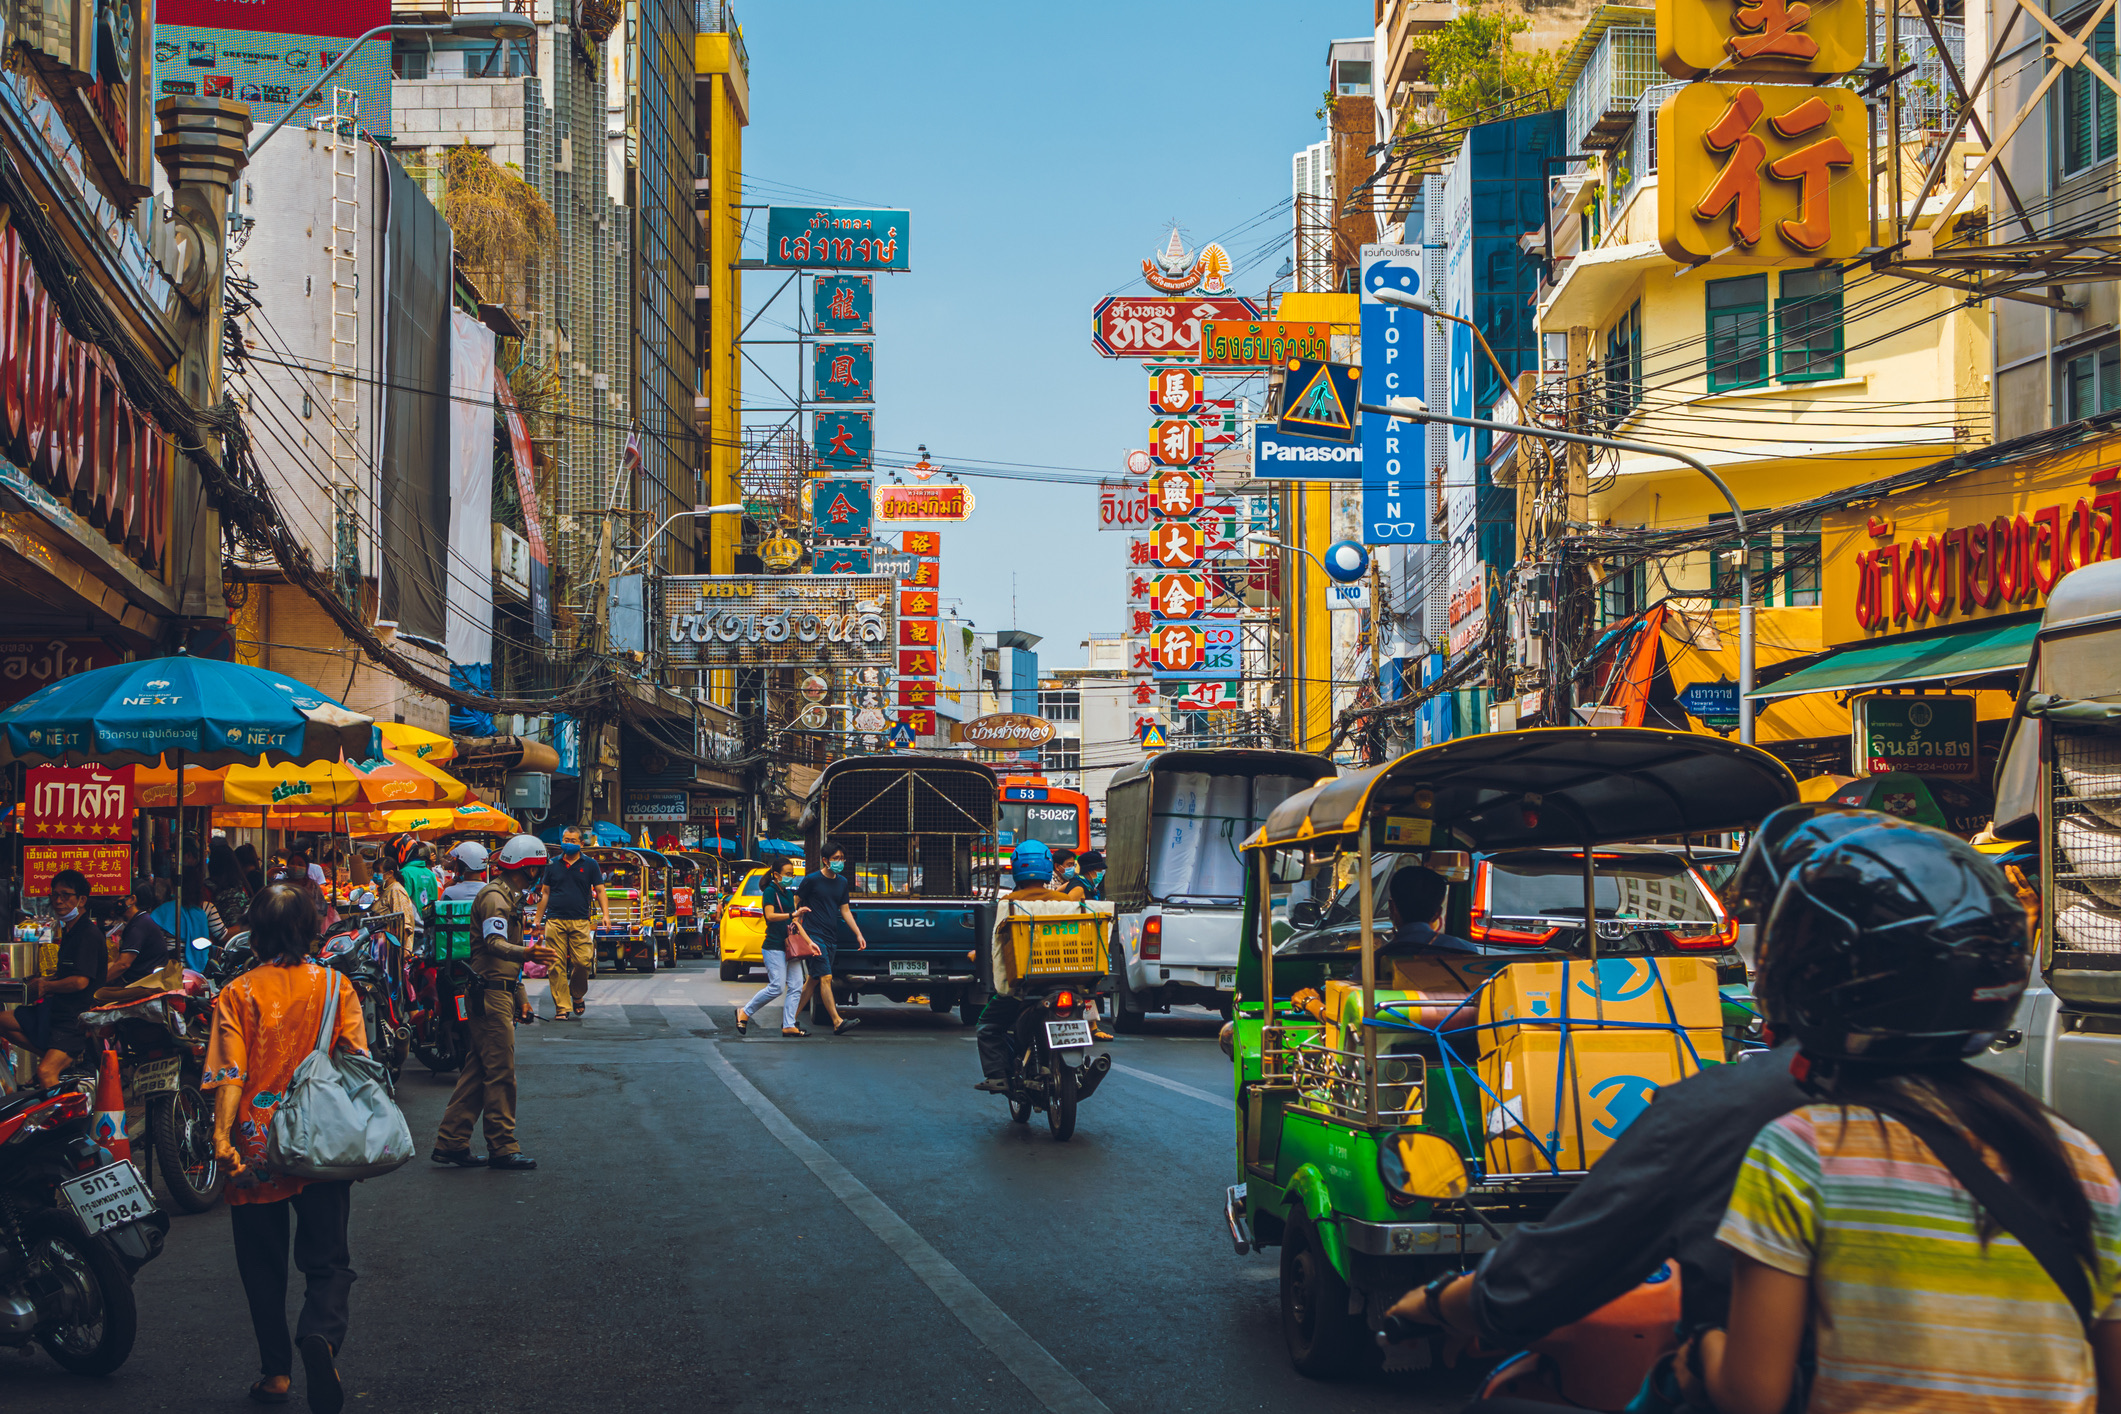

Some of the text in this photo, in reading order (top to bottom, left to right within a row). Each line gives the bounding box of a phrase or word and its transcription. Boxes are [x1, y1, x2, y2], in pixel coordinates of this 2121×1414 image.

[223, 51, 279, 60] GREYHOUND
[262, 85, 291, 94] TACO
[263, 93, 291, 103] BELL
[808, 212, 872, 230] ห้างทอง
[1111, 302, 1175, 318] ห้างทอง
[1203, 323, 1327, 361] โรงรับจำนำ
[1385, 307, 1400, 365] TOP
[1261, 441, 1363, 462] Panasoni
[702, 584, 753, 597] ทอง
[122, 696, 183, 706] NEXT
[1690, 690, 1732, 699] เยาวราช
[46, 734, 79, 745] NEXT
[247, 733, 286, 746] NEXT
[1872, 729, 1970, 756] จินฮั้วเฮง
[1020, 788, 1035, 799] 53
[1027, 808, 1076, 821] 6-50267
[888, 918, 936, 928] ISUZU
[906, 961, 927, 970] 3538
[93, 1200, 141, 1227] 7084
